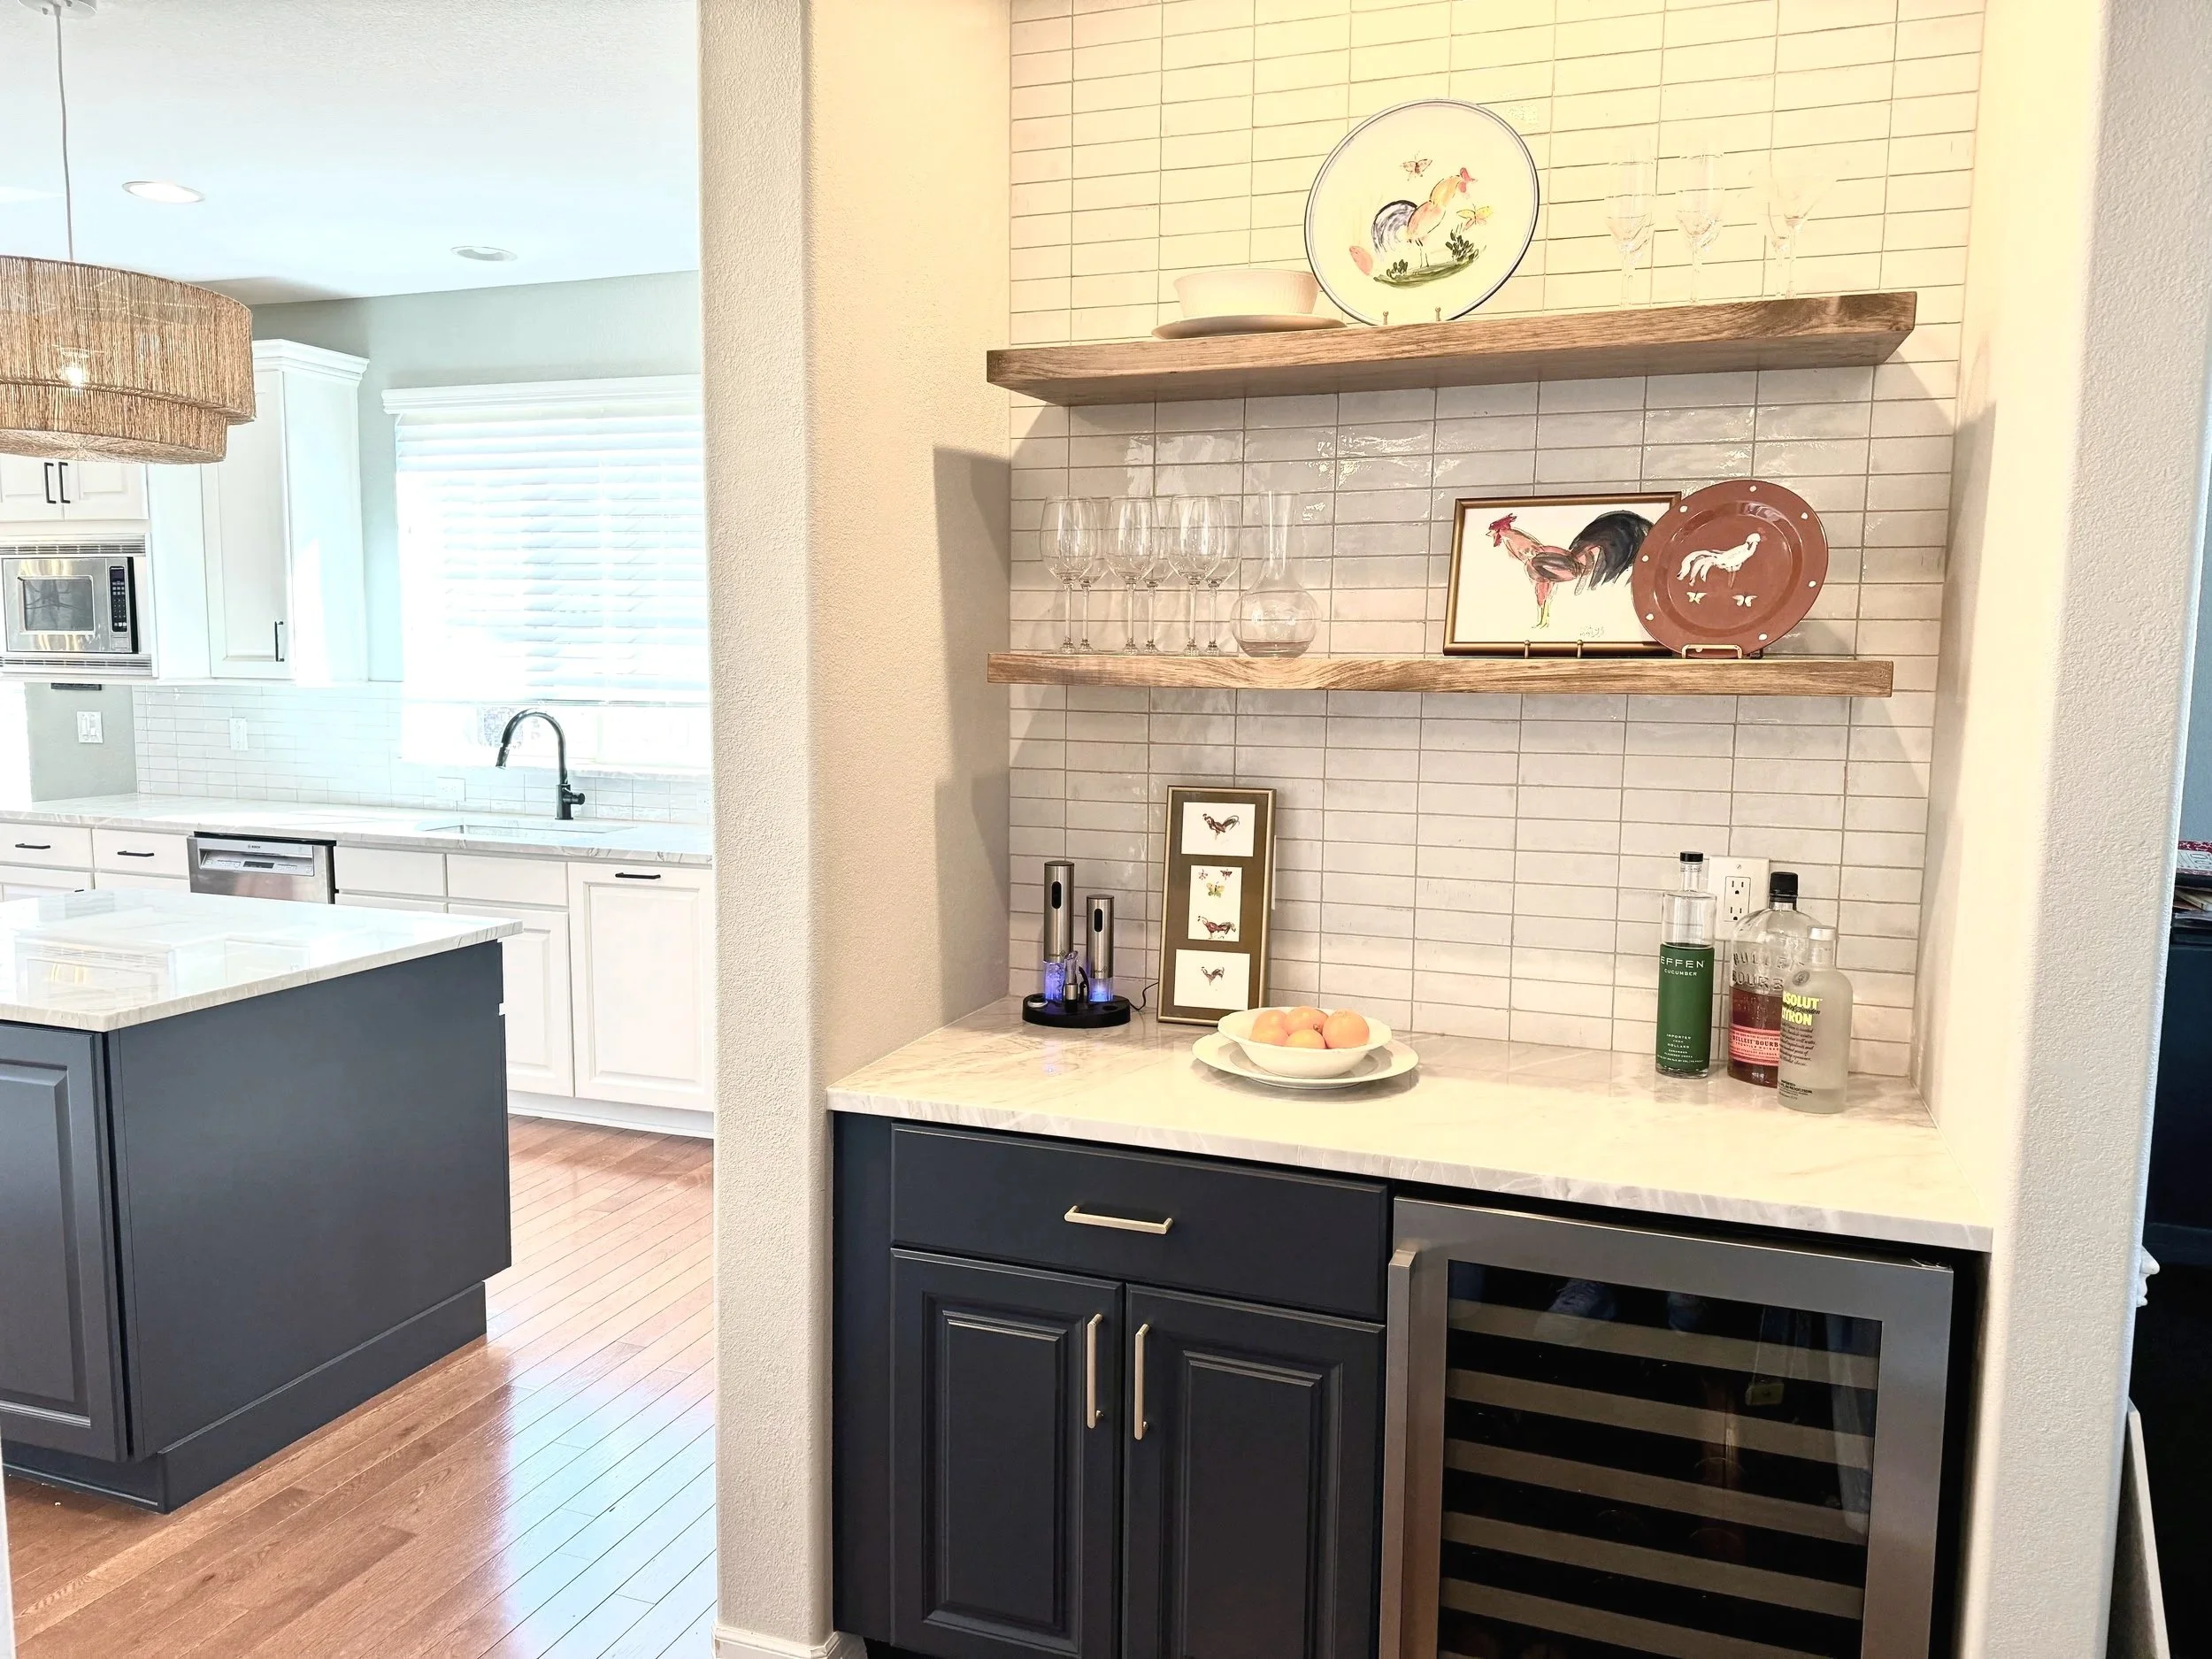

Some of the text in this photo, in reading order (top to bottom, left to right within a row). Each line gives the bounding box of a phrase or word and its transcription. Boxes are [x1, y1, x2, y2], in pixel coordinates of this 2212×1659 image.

[1660, 956, 1704, 968] EFFEN
[1732, 970, 1784, 990] BOURB
[1782, 990, 1820, 1010] BSOLUT
[1781, 1006, 1813, 1026] ITRON
